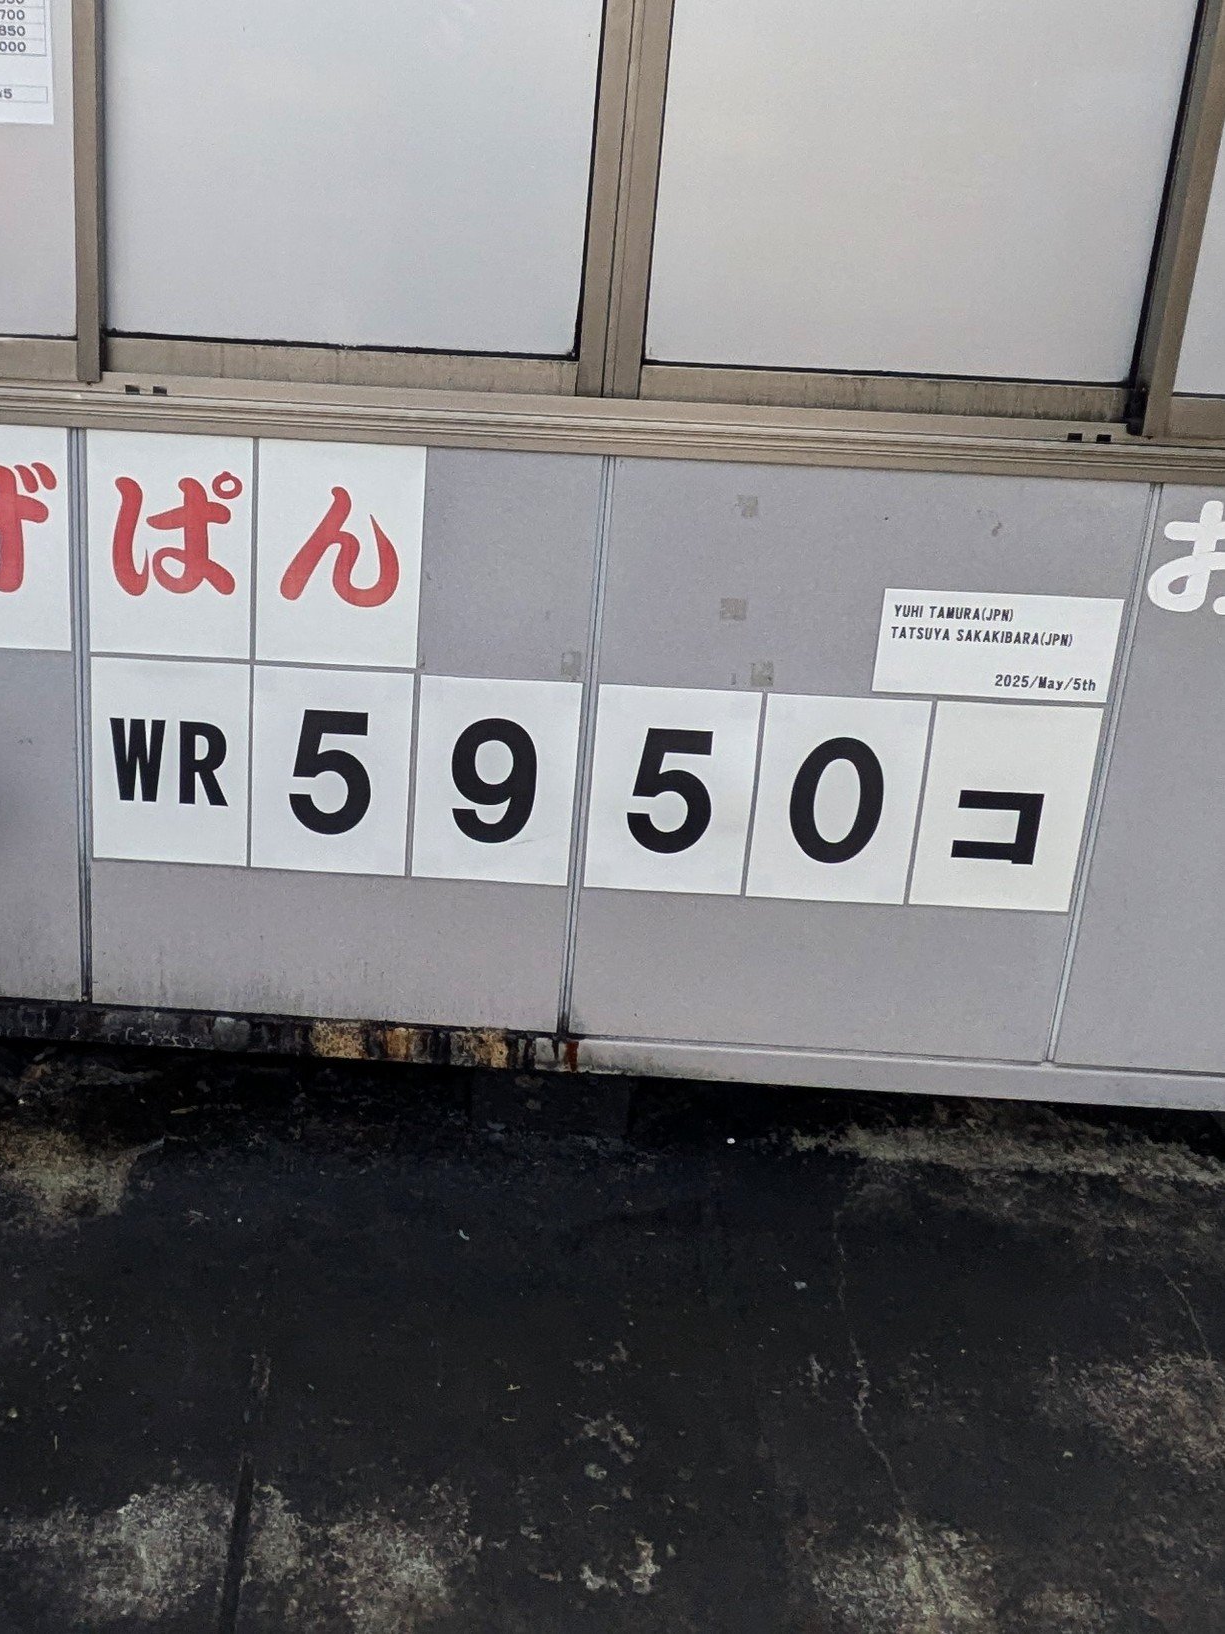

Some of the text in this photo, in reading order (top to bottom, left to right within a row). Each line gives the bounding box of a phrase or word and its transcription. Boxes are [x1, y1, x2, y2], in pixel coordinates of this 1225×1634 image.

[894, 604, 1015, 623] YUHI TAMURA(JPN)
[891, 626, 1074, 648] TATSUYA SAKAKIBARA(JPN)
[994, 674, 1097, 692] 2025/May/5th
[110, 717, 228, 808] WR
